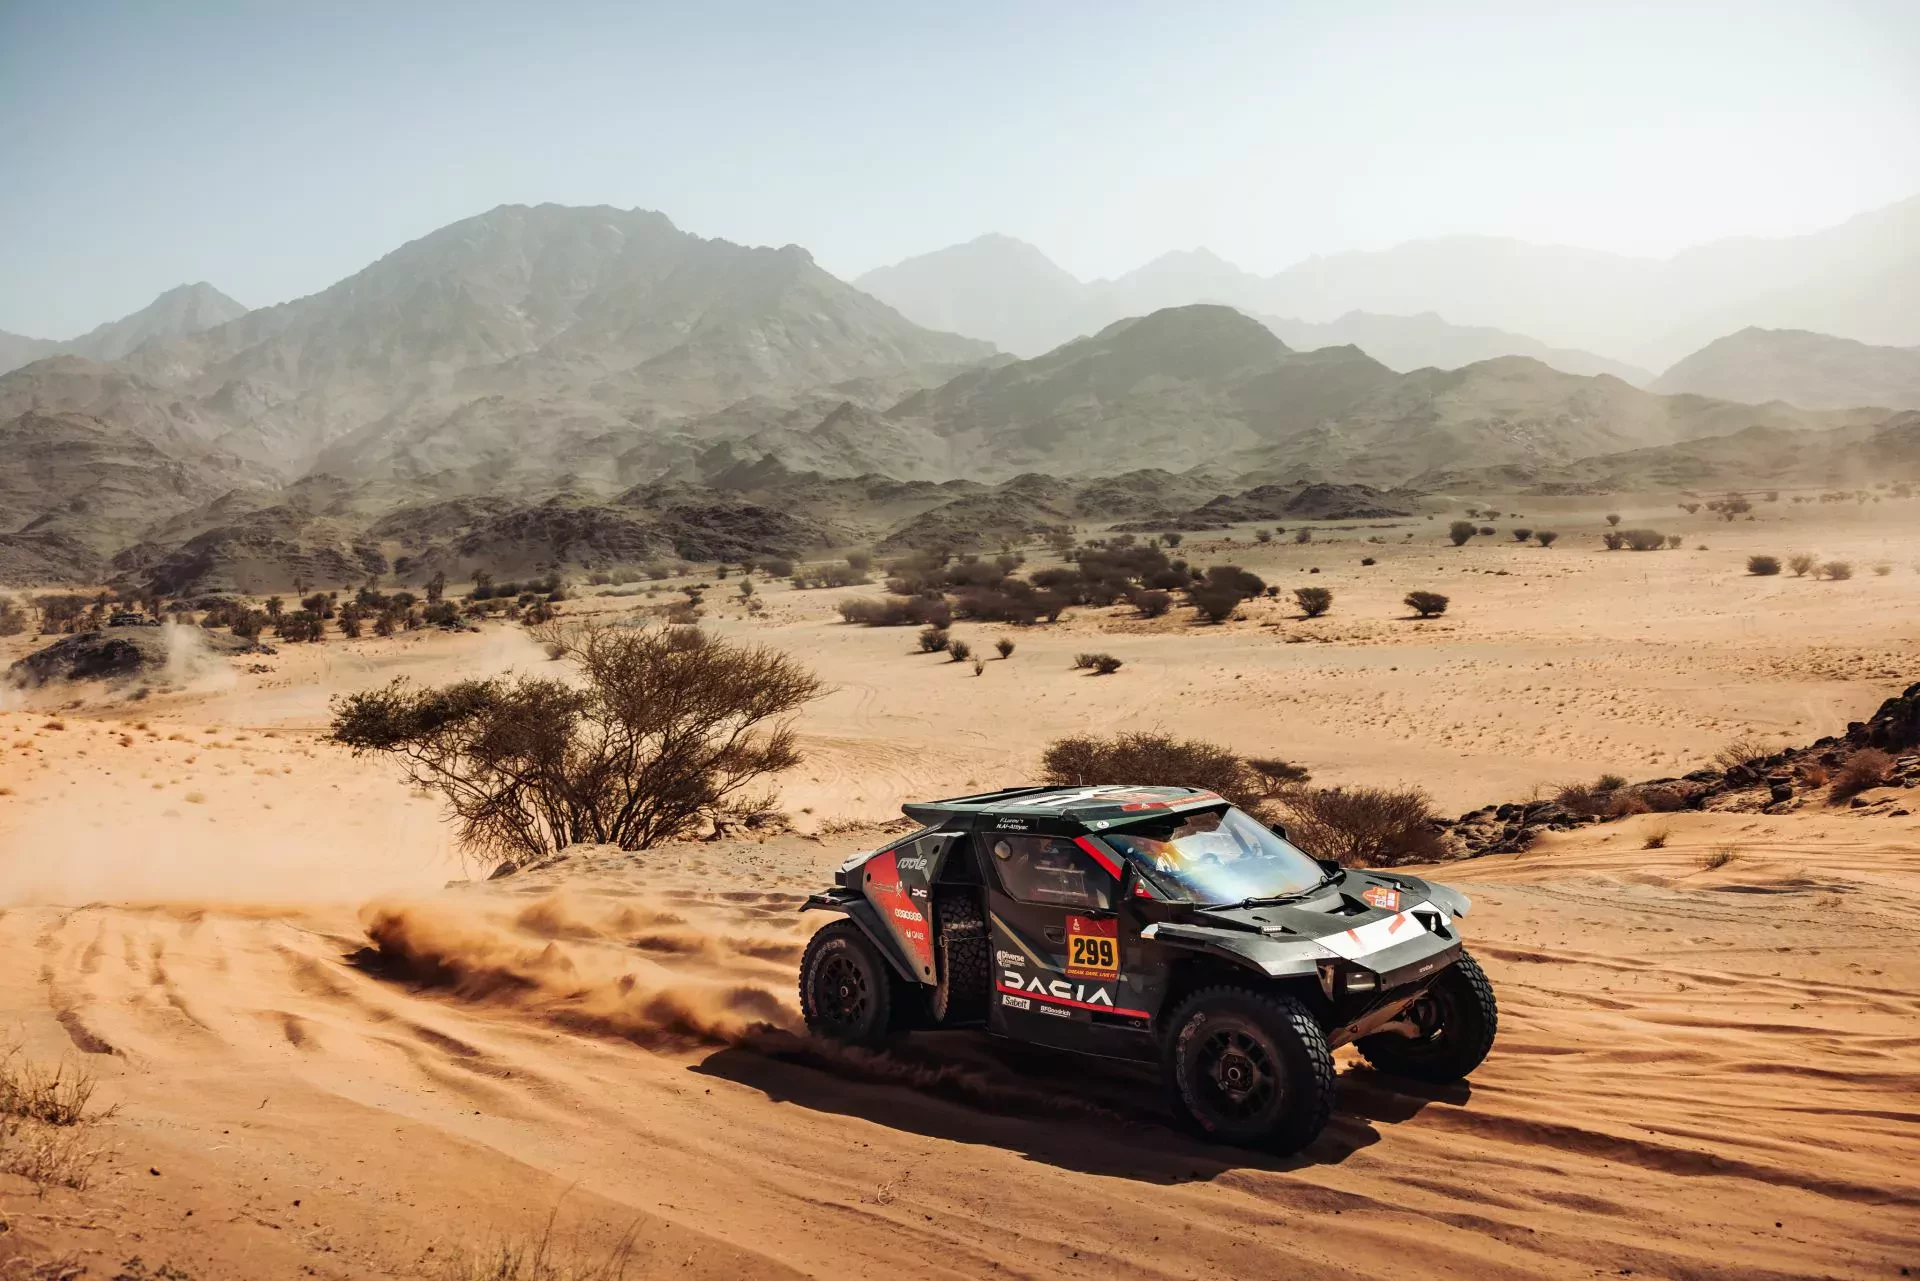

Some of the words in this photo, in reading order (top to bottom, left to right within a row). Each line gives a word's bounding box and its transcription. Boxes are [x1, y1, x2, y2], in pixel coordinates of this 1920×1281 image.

[1001, 950, 1025, 963] Diverse
[1073, 937, 1114, 967] 299
[1004, 970, 1114, 1007] DACIA
[1005, 997, 1027, 1009] Sabelt
[1040, 1005, 1071, 1017] BFGoodrich
